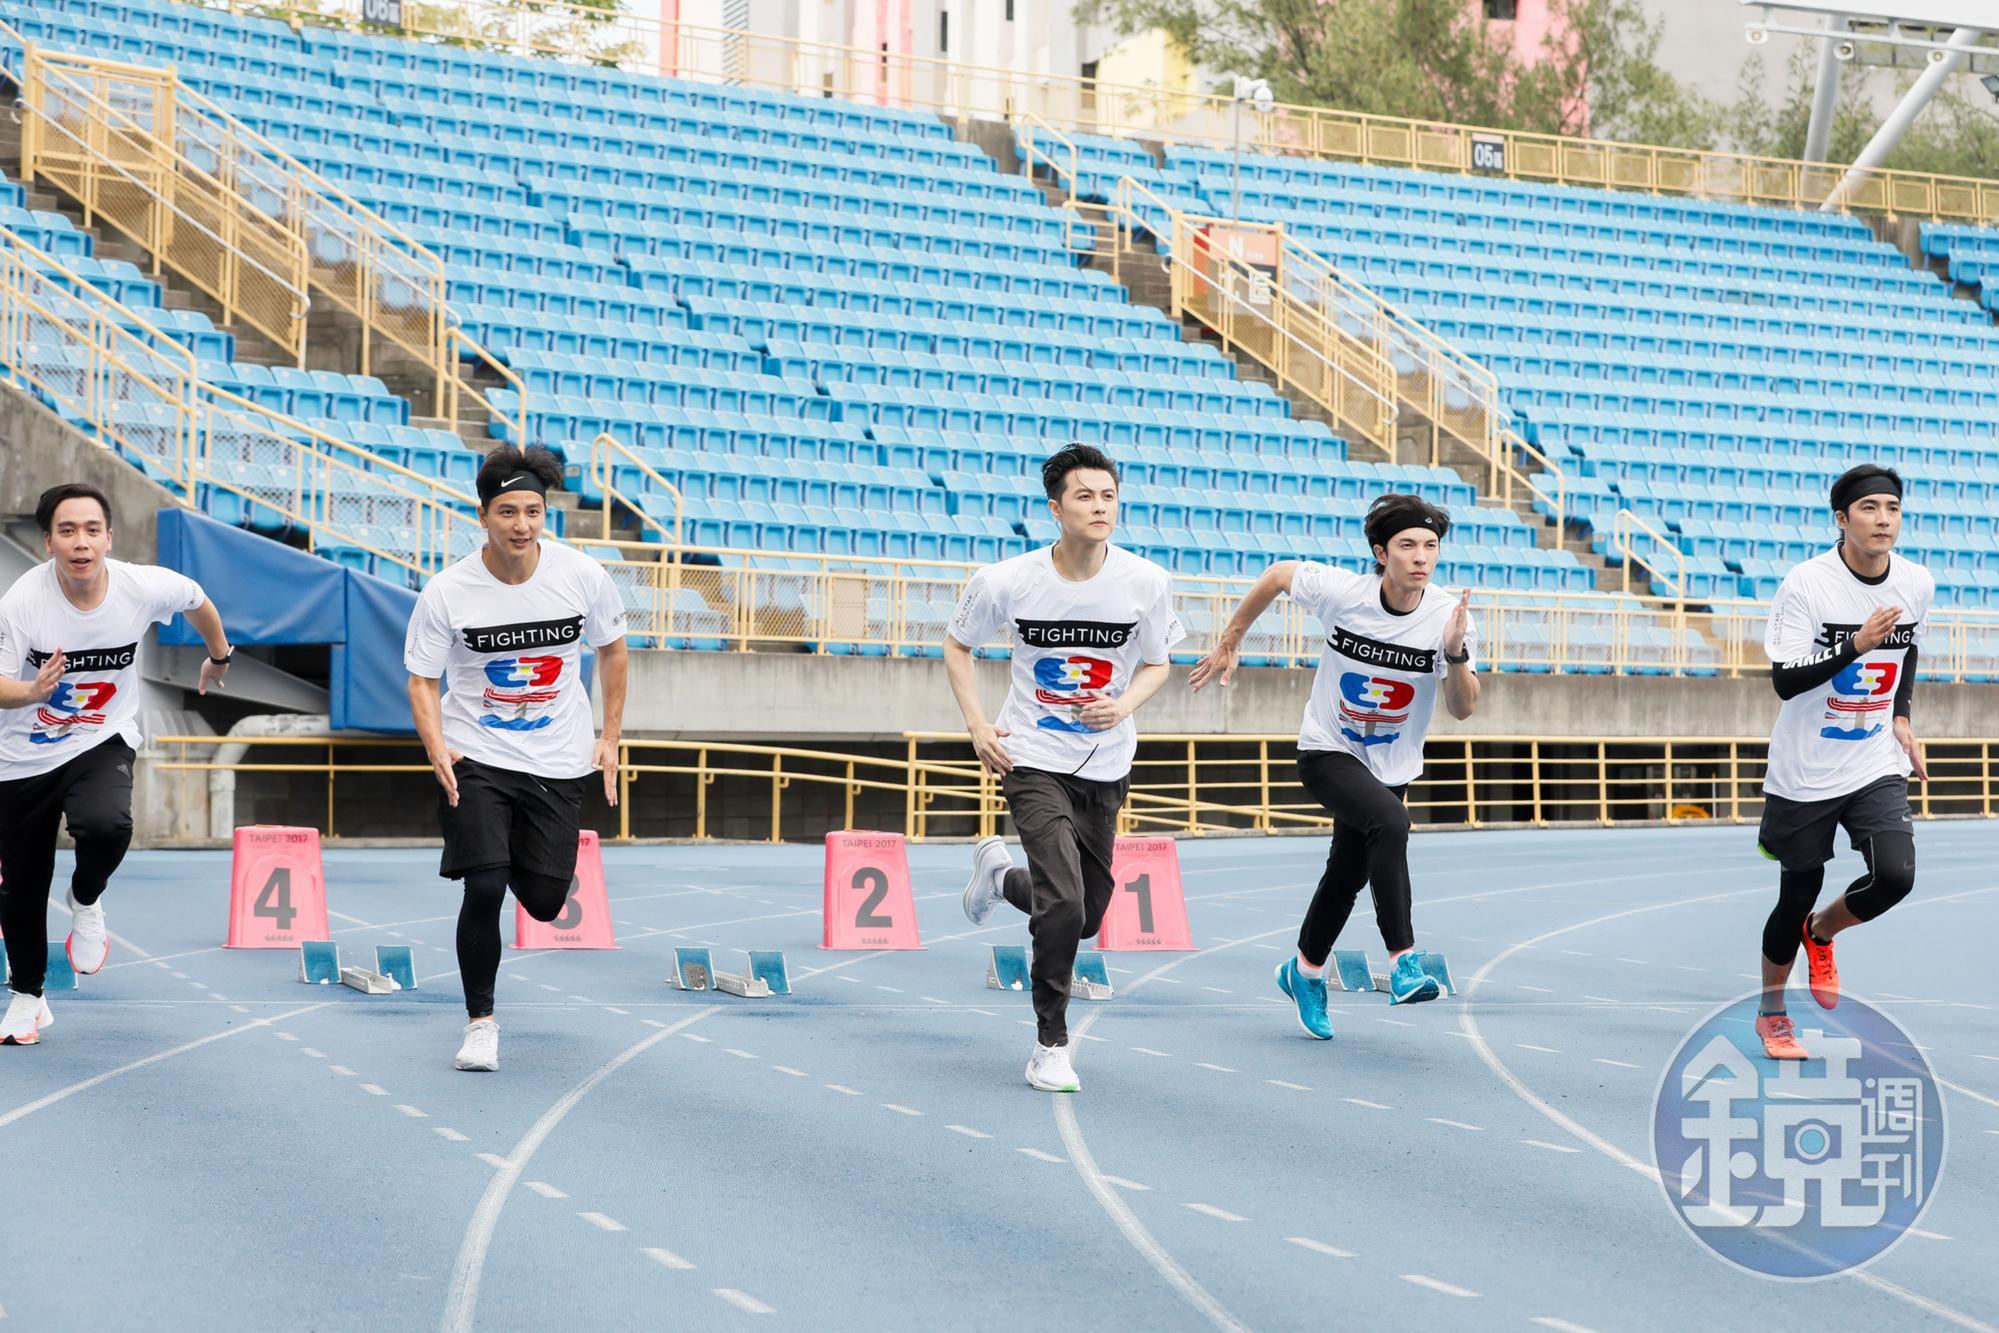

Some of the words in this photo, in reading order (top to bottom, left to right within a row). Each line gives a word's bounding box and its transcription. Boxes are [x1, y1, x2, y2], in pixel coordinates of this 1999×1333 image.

[1474, 143, 1503, 168] 05
[477, 625, 574, 648] FIGHTING
[1028, 627, 1124, 643] FIGHTING
[41, 652, 131, 670] FGHTING
[1341, 637, 1427, 667] FIGHTING
[249, 834, 282, 844] TAIPEI
[285, 834, 309, 844] 2017
[842, 839, 872, 848] TAIPEI
[875, 840, 896, 848] 2017
[1116, 843, 1144, 852] TAIPEI
[1147, 843, 1168, 851] 2017
[253, 867, 297, 930] 4
[851, 867, 893, 928] 2
[1124, 873, 1155, 933] 1
